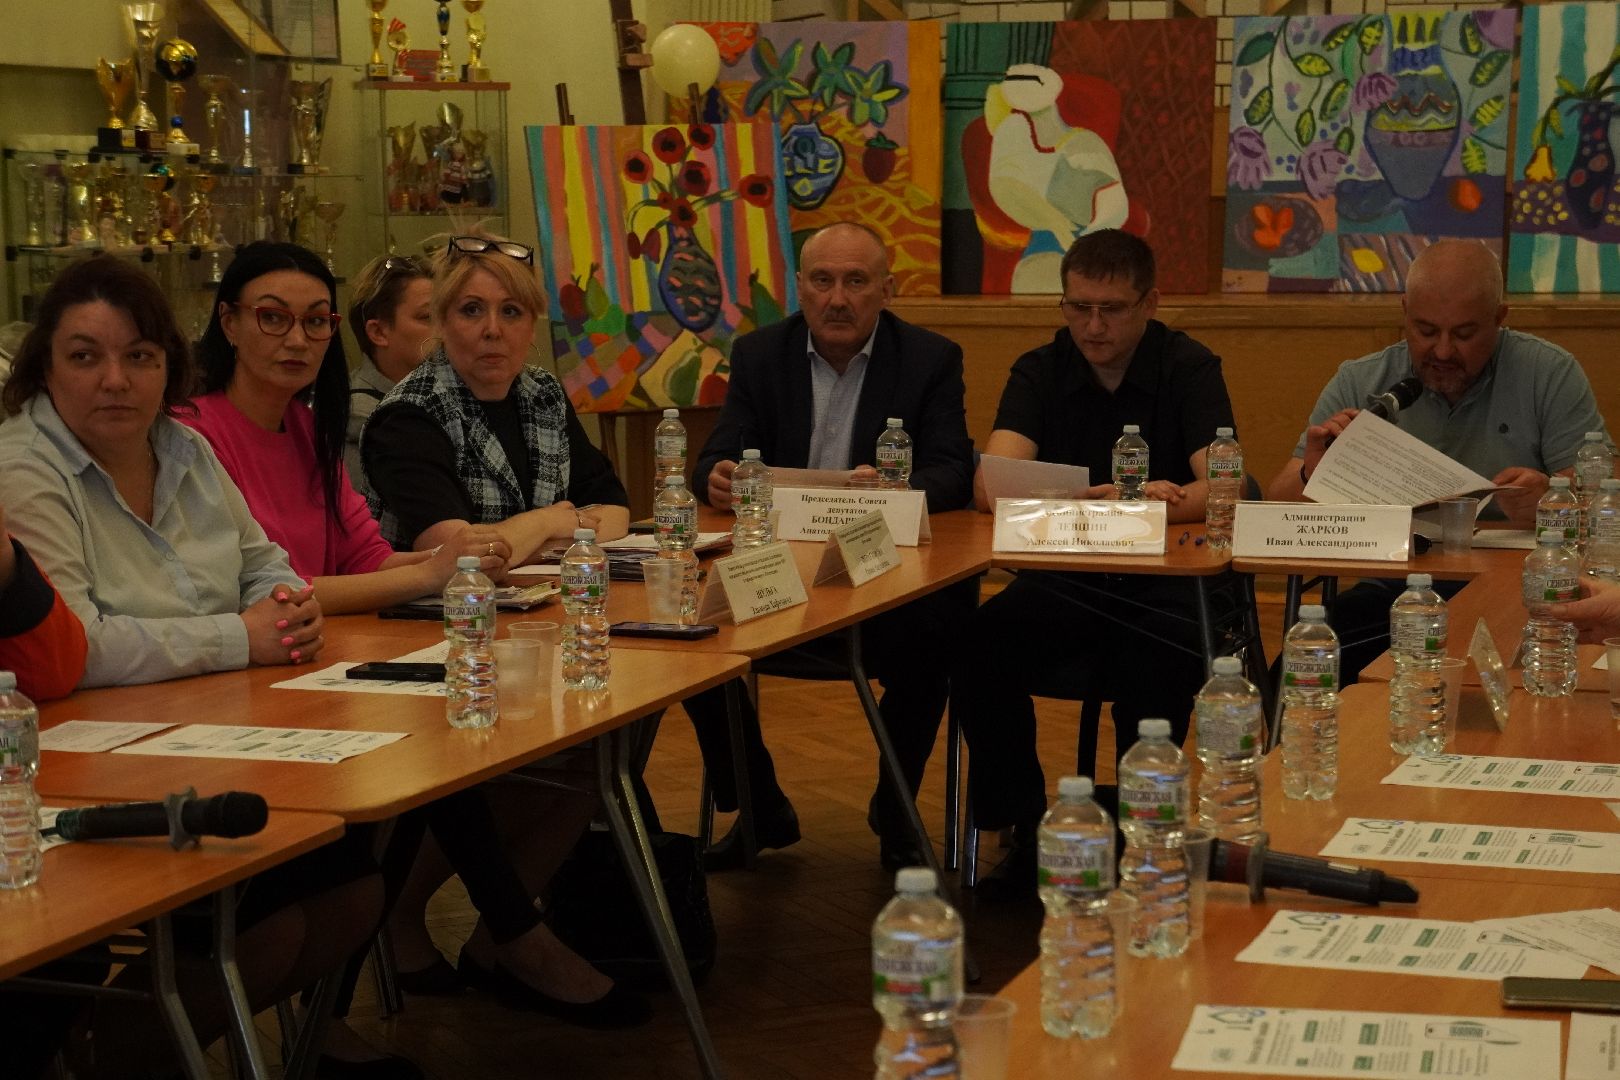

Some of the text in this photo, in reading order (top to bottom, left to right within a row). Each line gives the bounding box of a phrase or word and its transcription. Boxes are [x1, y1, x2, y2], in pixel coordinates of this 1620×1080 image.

[801, 494, 887, 505] Председатель Совета
[826, 507, 867, 516] депутатов
[1282, 513, 1366, 523] Администрация
[800, 527, 832, 535] Анатол
[1297, 525, 1349, 535] ЖАРКОВ
[1027, 537, 1134, 547] Алексей Николаевич
[1266, 537, 1378, 549] Иван Александрович
